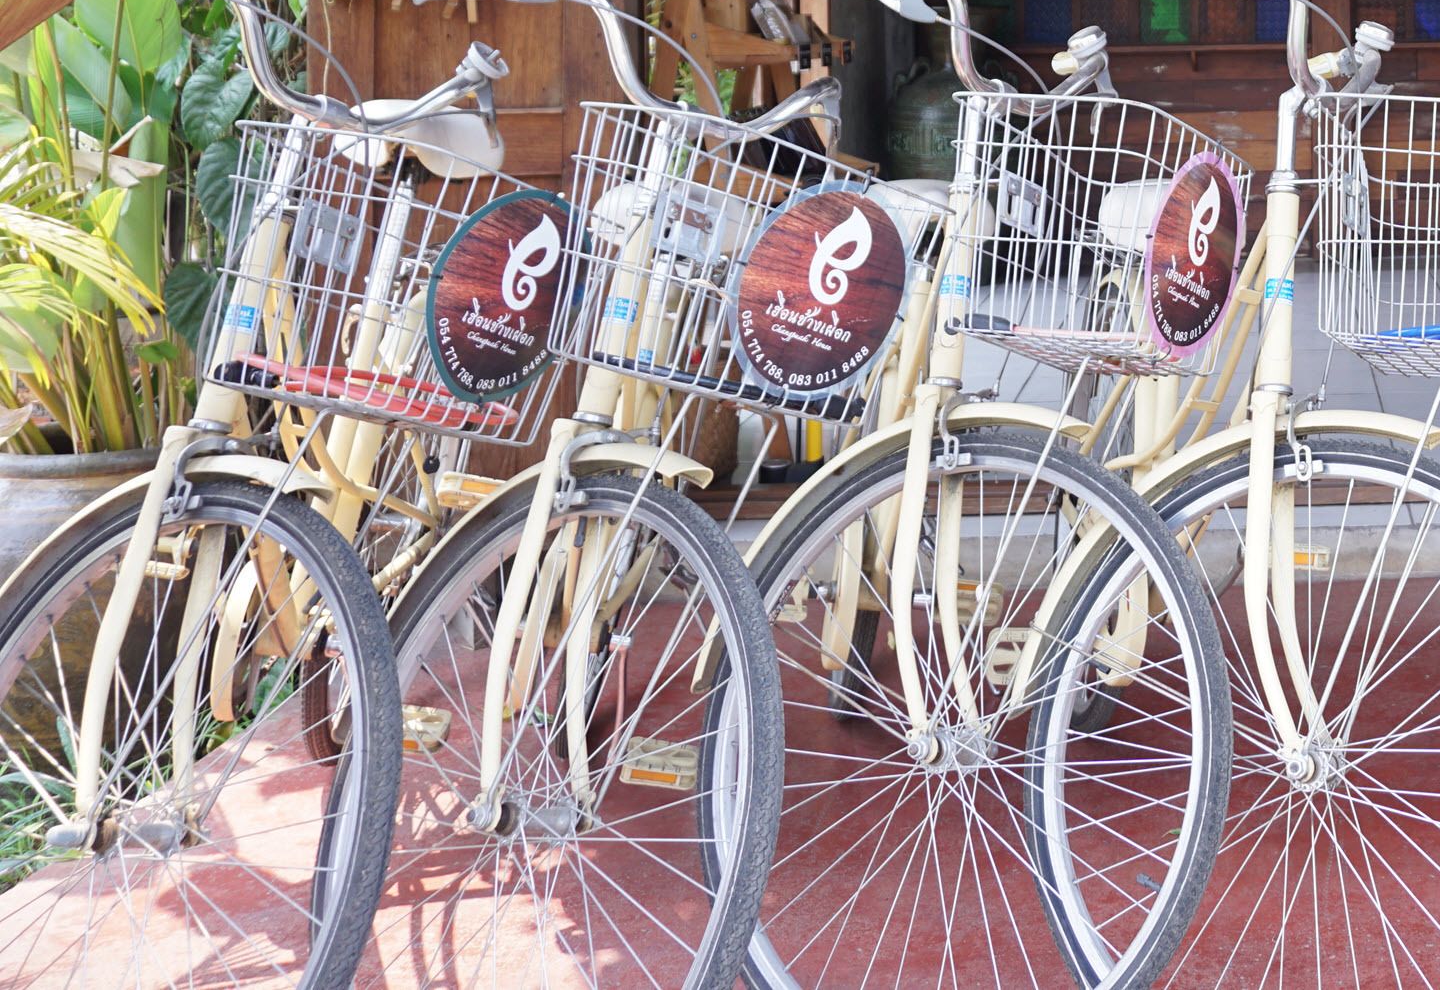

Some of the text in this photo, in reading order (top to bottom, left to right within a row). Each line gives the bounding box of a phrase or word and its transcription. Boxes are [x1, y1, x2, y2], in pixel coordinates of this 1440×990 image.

[439, 317, 547, 390] 054 774 788, 083 011 8488
[742, 310, 869, 386] 054 774 788, 083 011 8488
